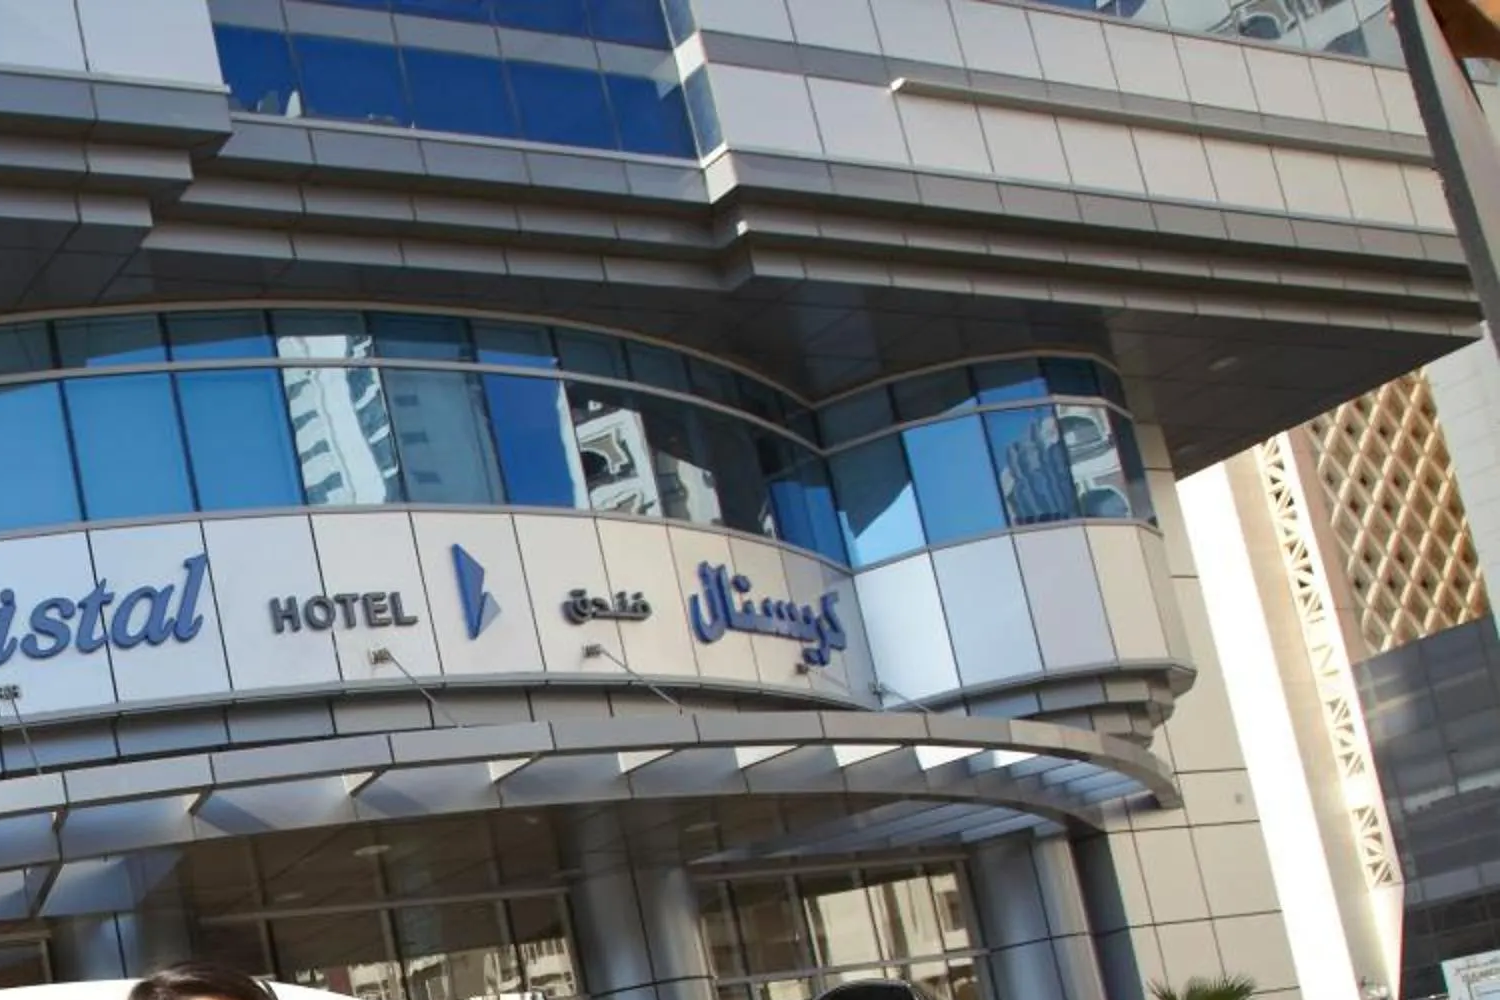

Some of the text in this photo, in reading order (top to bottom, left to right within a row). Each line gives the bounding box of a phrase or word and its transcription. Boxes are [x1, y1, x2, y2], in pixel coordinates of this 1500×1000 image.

[269, 591, 419, 634] HOTEL
[561, 560, 846, 667] كريستال فندق
